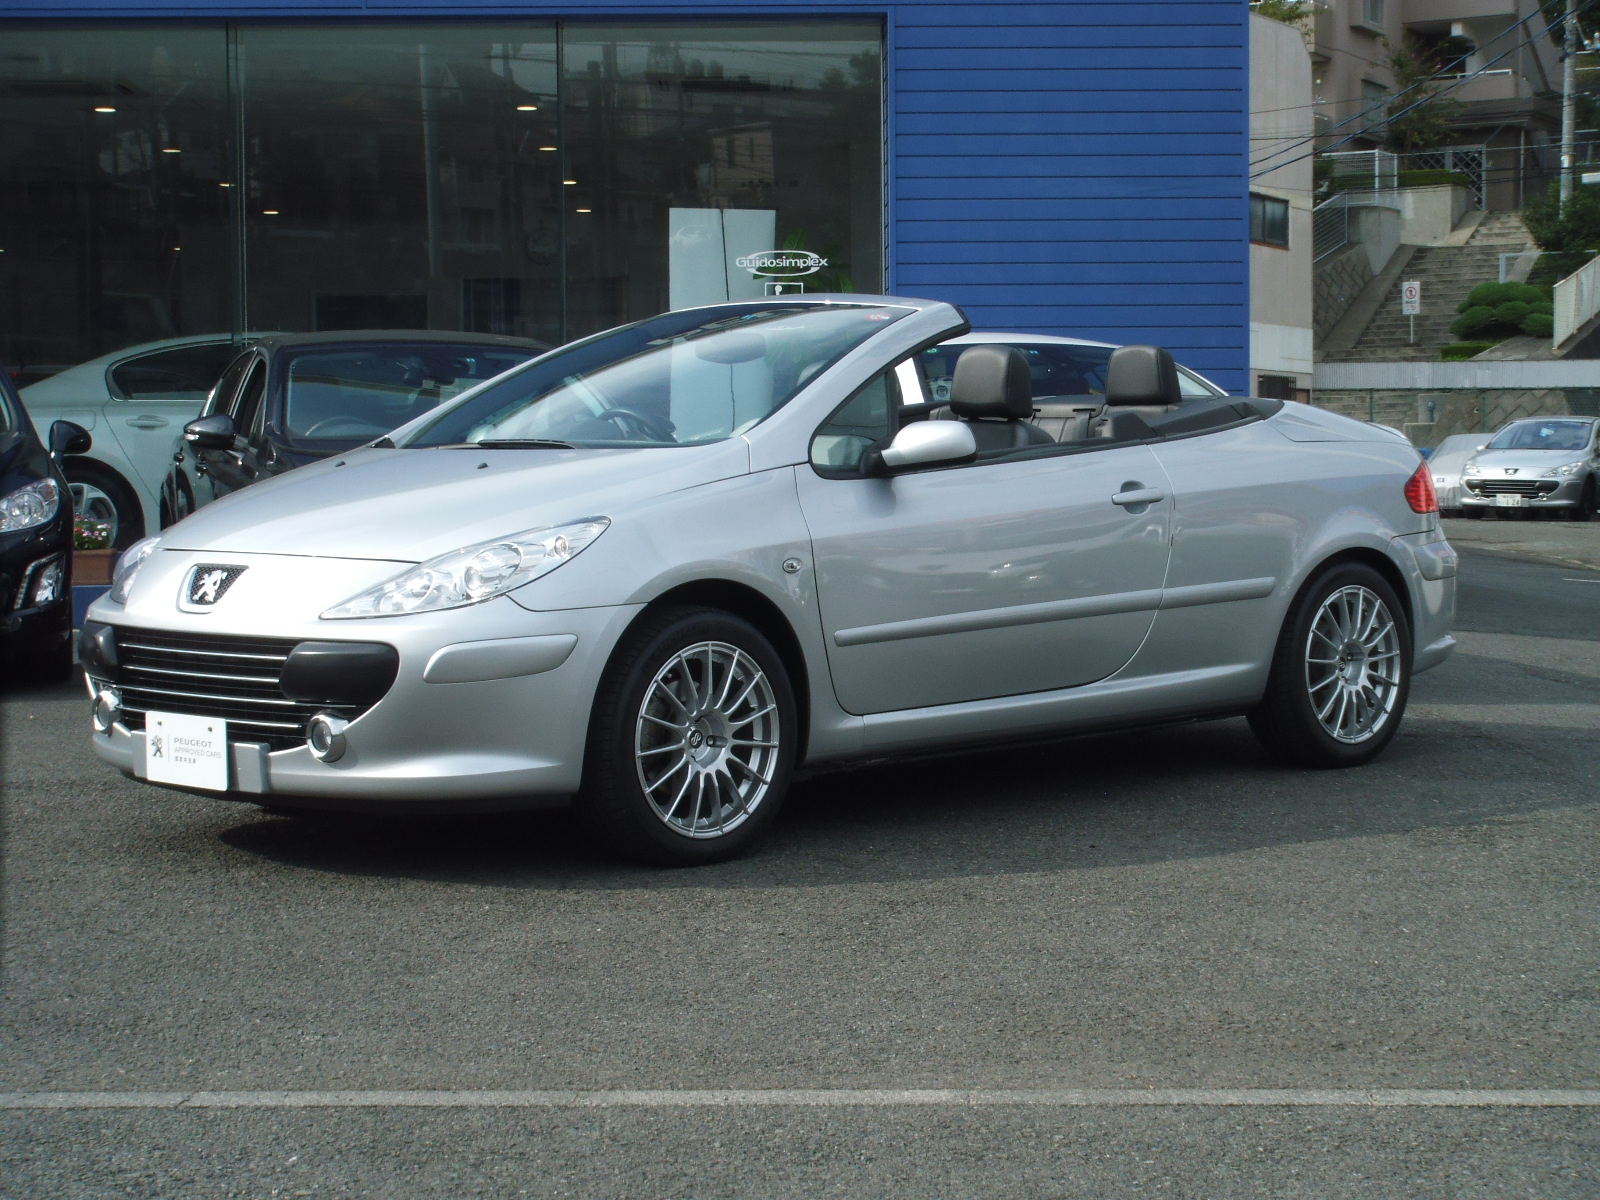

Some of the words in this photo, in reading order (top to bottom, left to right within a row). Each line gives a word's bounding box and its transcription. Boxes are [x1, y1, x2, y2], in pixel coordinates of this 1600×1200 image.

[736, 256, 828, 268] Guidosimplex
[174, 737, 212, 748] PEUGEOT
[205, 750, 222, 759] CARS
